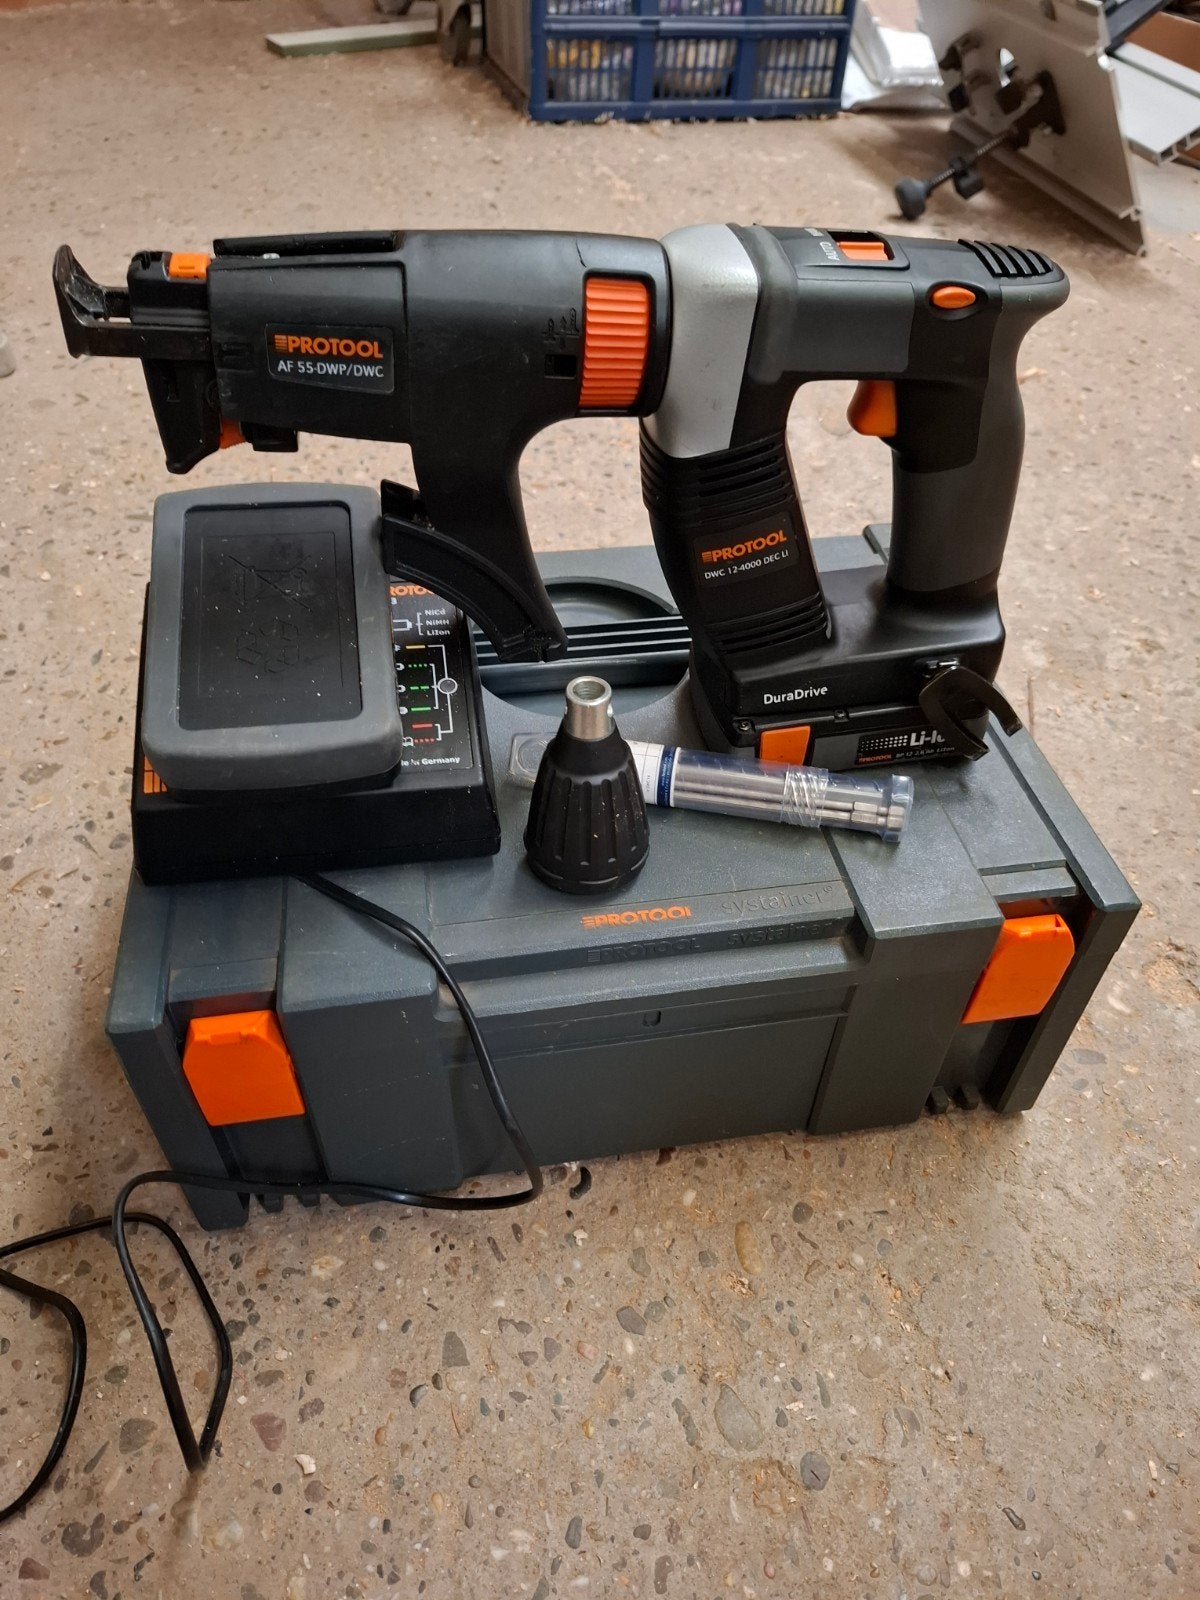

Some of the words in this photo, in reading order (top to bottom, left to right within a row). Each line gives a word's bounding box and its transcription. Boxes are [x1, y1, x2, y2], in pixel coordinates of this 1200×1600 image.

[287, 335, 384, 358] PROTOOL
[277, 360, 294, 373] AF
[297, 361, 385, 378] 55-DWP/DWC
[711, 529, 787, 562] PROTOOL
[704, 569, 726, 580] DWC
[727, 559, 762, 575] 12-4000
[763, 553, 781, 565] DEC
[763, 685, 829, 705] DuraDrive
[421, 756, 461, 765] Germany
